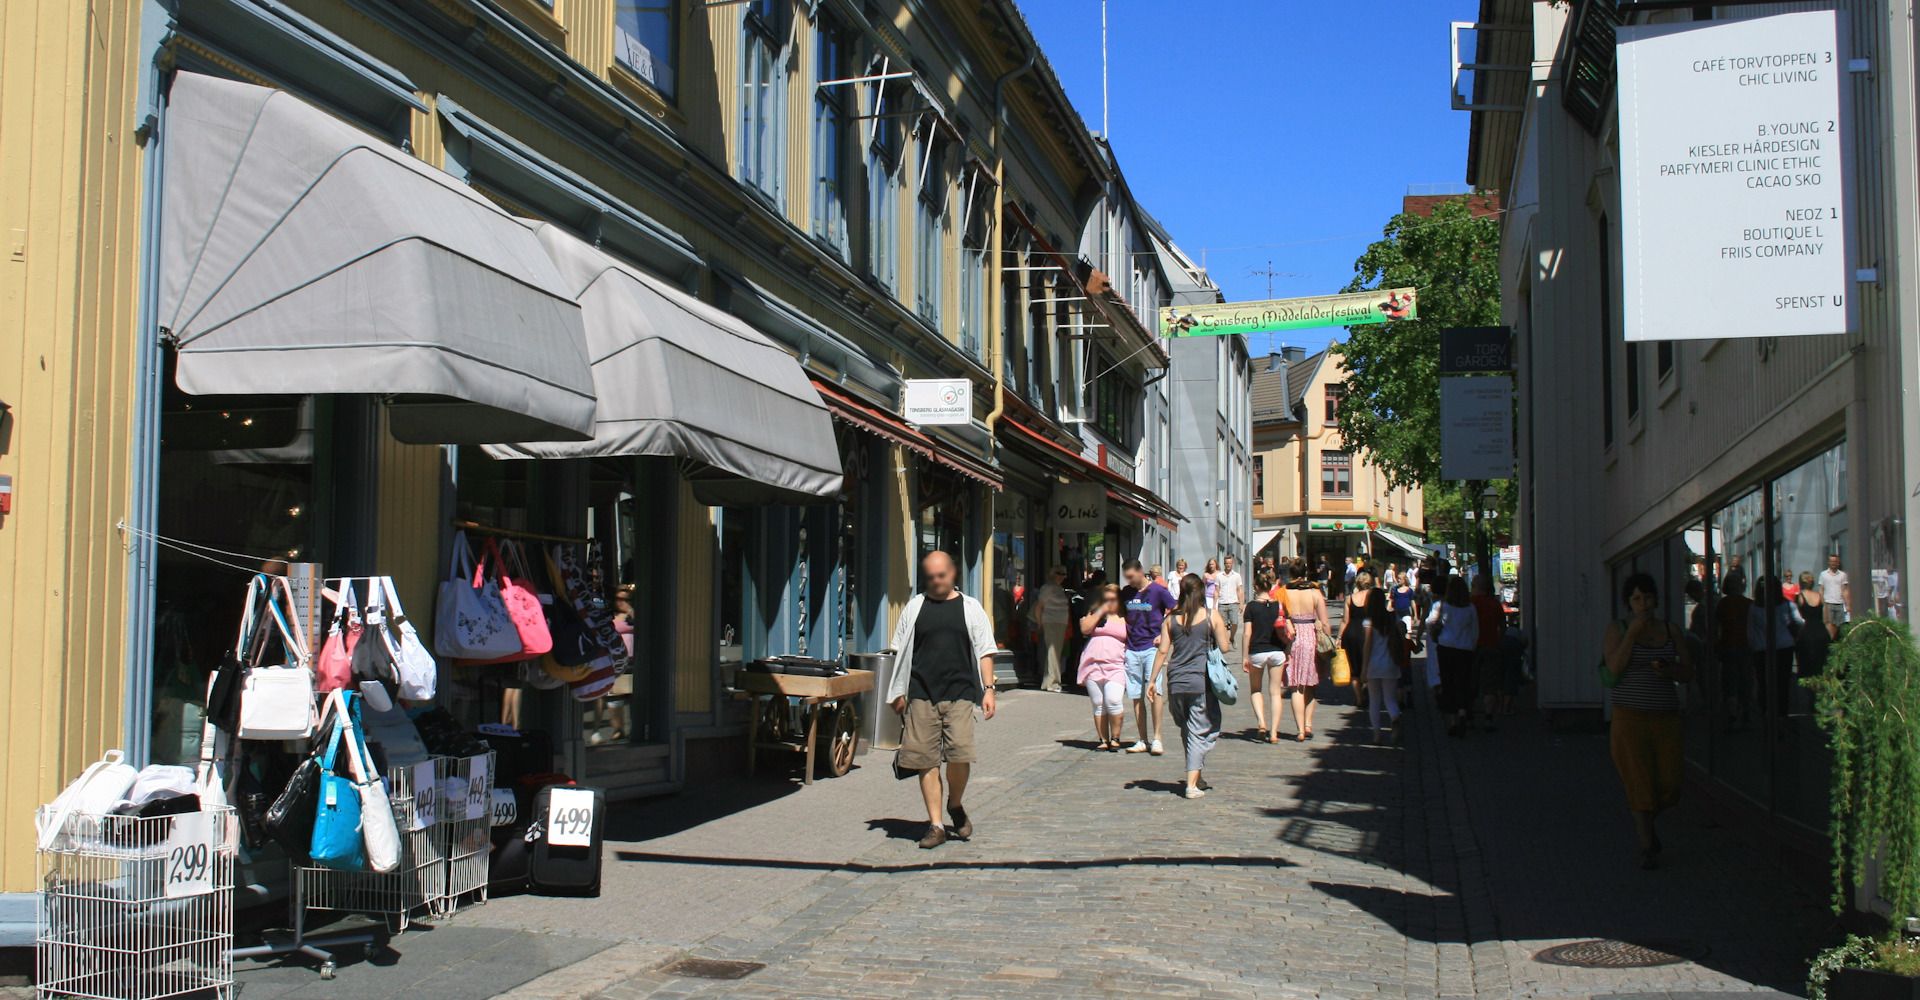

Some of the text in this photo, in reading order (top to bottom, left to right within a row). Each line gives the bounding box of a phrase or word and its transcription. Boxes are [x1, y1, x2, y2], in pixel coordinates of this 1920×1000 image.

[1692, 51, 1832, 73] CAFÉ TORVTOPPEN 3
[1738, 69, 1818, 86] CHIC LIVING
[1757, 120, 1835, 137] B.YOUNG 2
[1688, 139, 1820, 158] KIESLER HÅRDESIGN
[1660, 155, 1821, 176] PARFYMERI CLINIC ETHIC
[1746, 173, 1821, 189] CACAO SKO
[1785, 207, 1838, 221] NEOZ 1
[1743, 226, 1824, 241] BOUTIQUE L
[1721, 243, 1824, 259] FRIIS COMPANY
[1775, 295, 1843, 309] SPENST U
[1474, 344, 1506, 355] TORV
[1456, 354, 1507, 368] GÅRDEN
